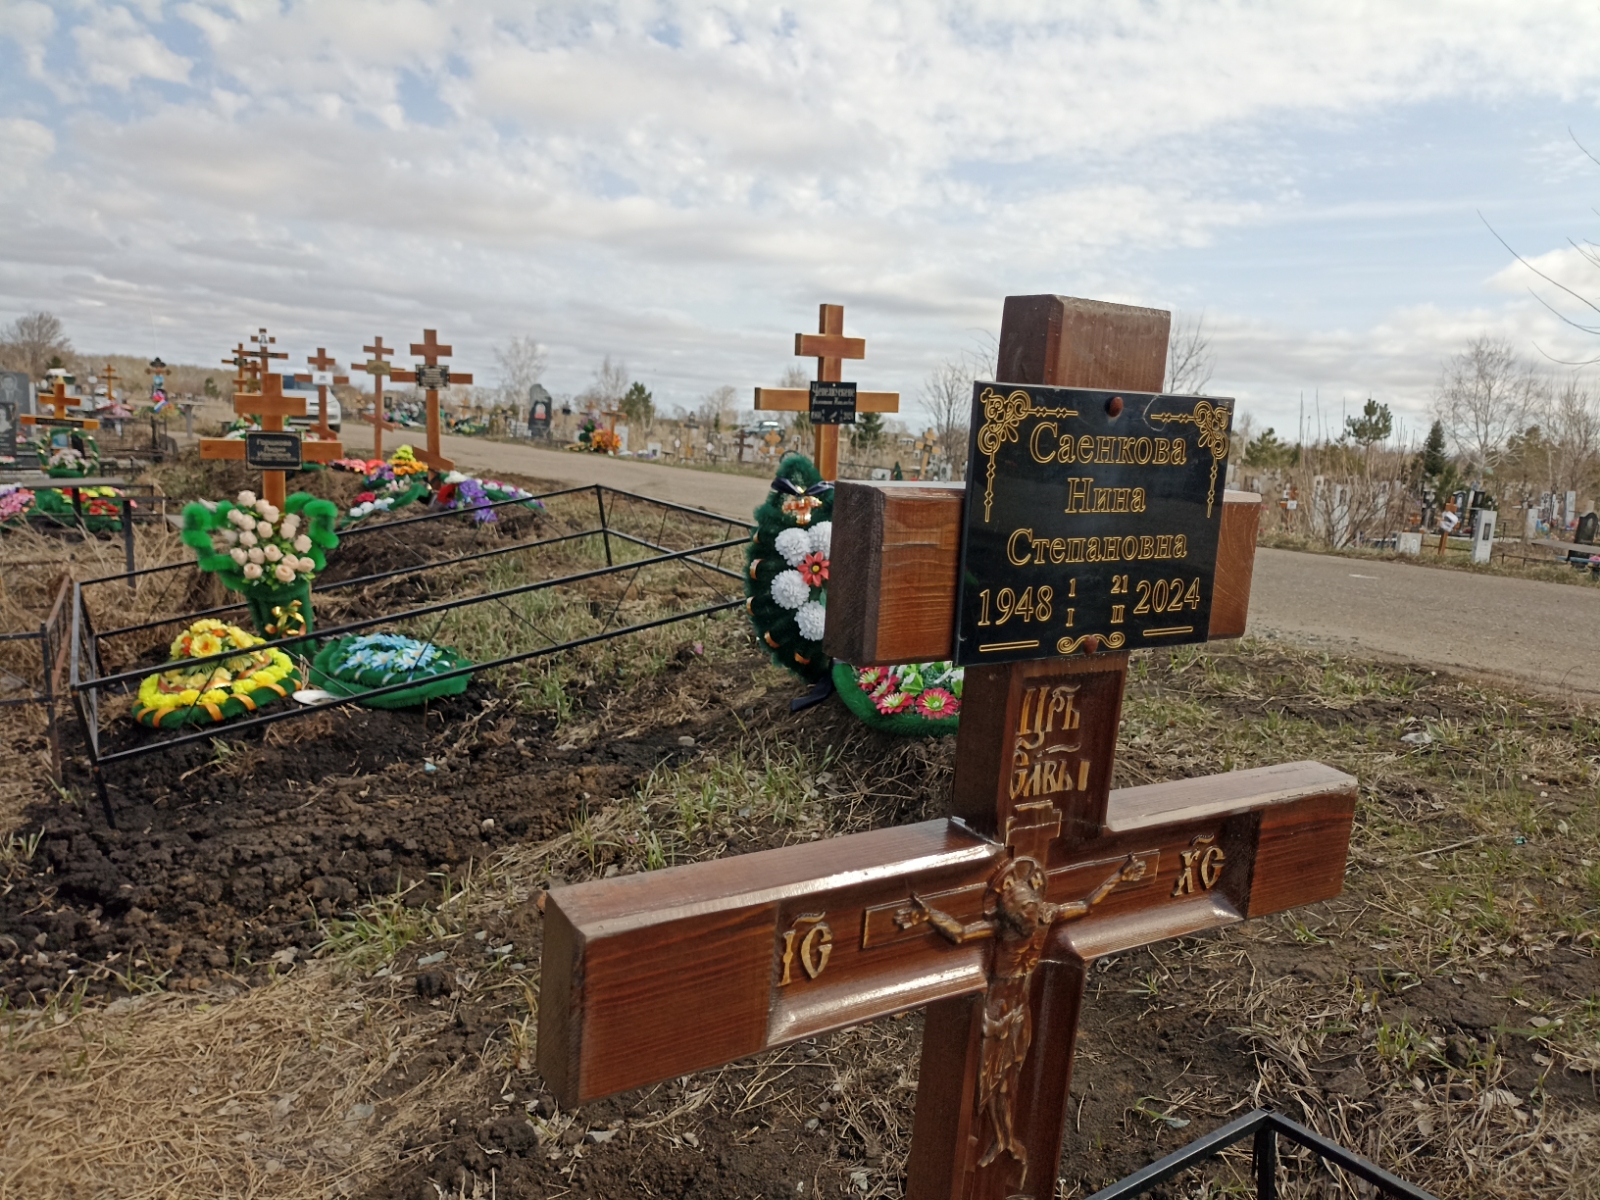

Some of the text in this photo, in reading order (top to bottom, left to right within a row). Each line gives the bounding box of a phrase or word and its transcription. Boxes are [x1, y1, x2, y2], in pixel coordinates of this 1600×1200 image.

[1029, 421, 1187, 465] Саенкова
[1064, 477, 1147, 514] Нина
[1007, 528, 1188, 566] Степановна
[977, 585, 1053, 626] 1948
[1111, 575, 1128, 594] 21
[1133, 577, 1200, 615] 2024
